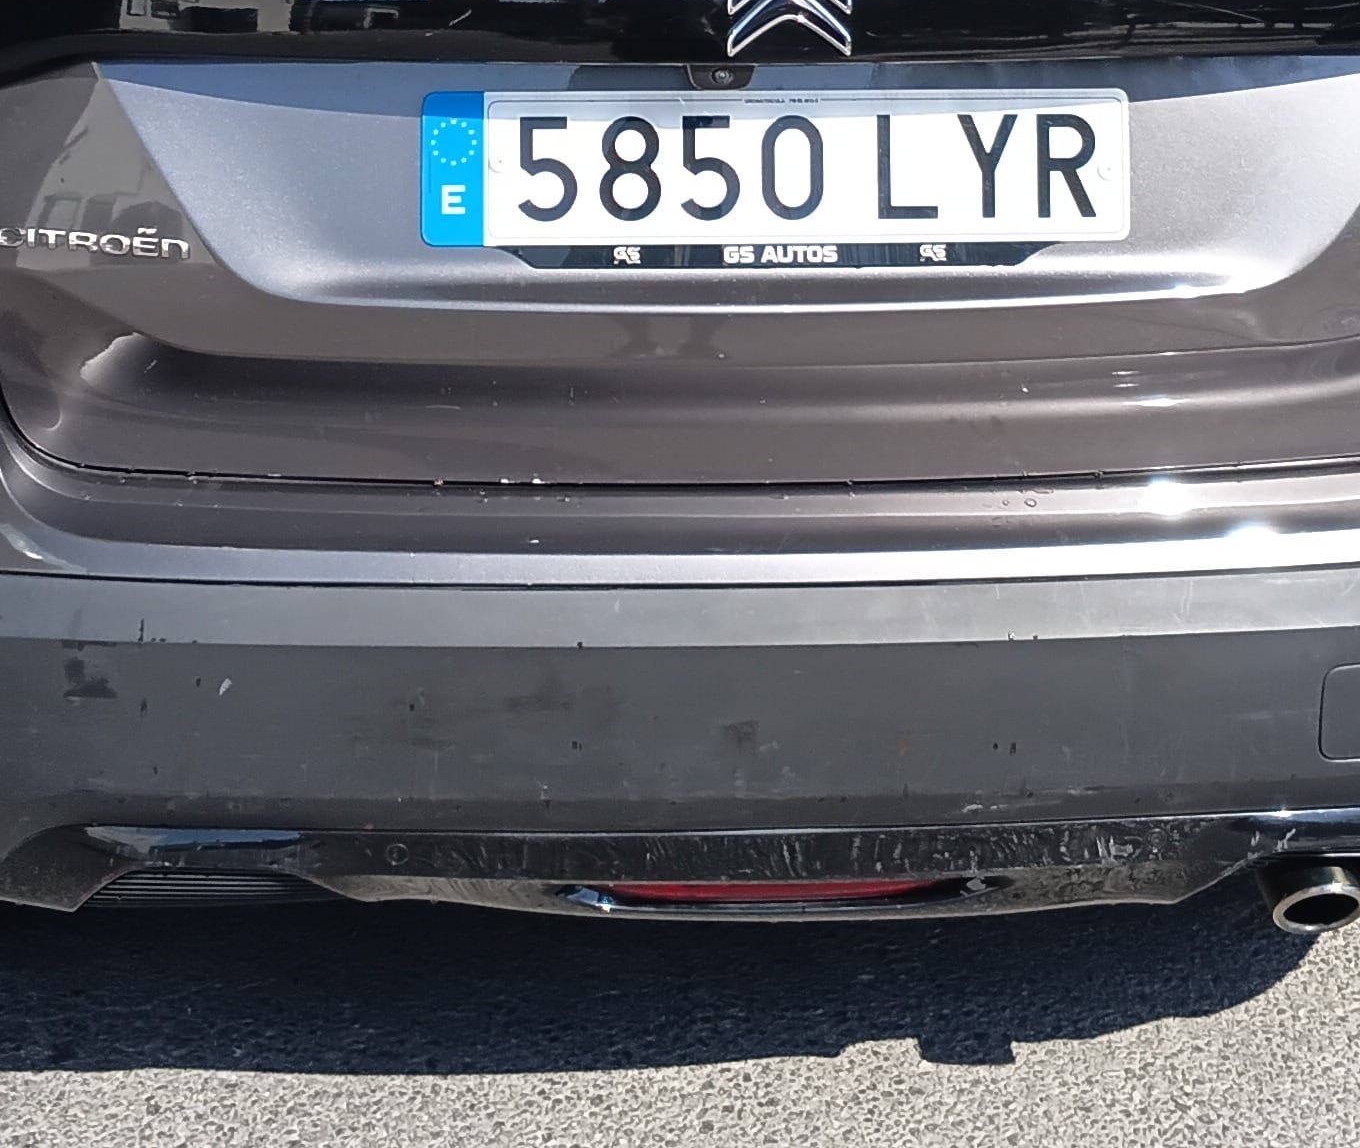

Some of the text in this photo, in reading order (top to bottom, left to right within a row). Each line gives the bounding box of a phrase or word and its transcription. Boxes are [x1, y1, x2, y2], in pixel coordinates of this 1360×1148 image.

[518, 113, 1097, 223] 5850 LYR
[441, 184, 466, 215] E
[723, 244, 839, 264] GS AUTOS
